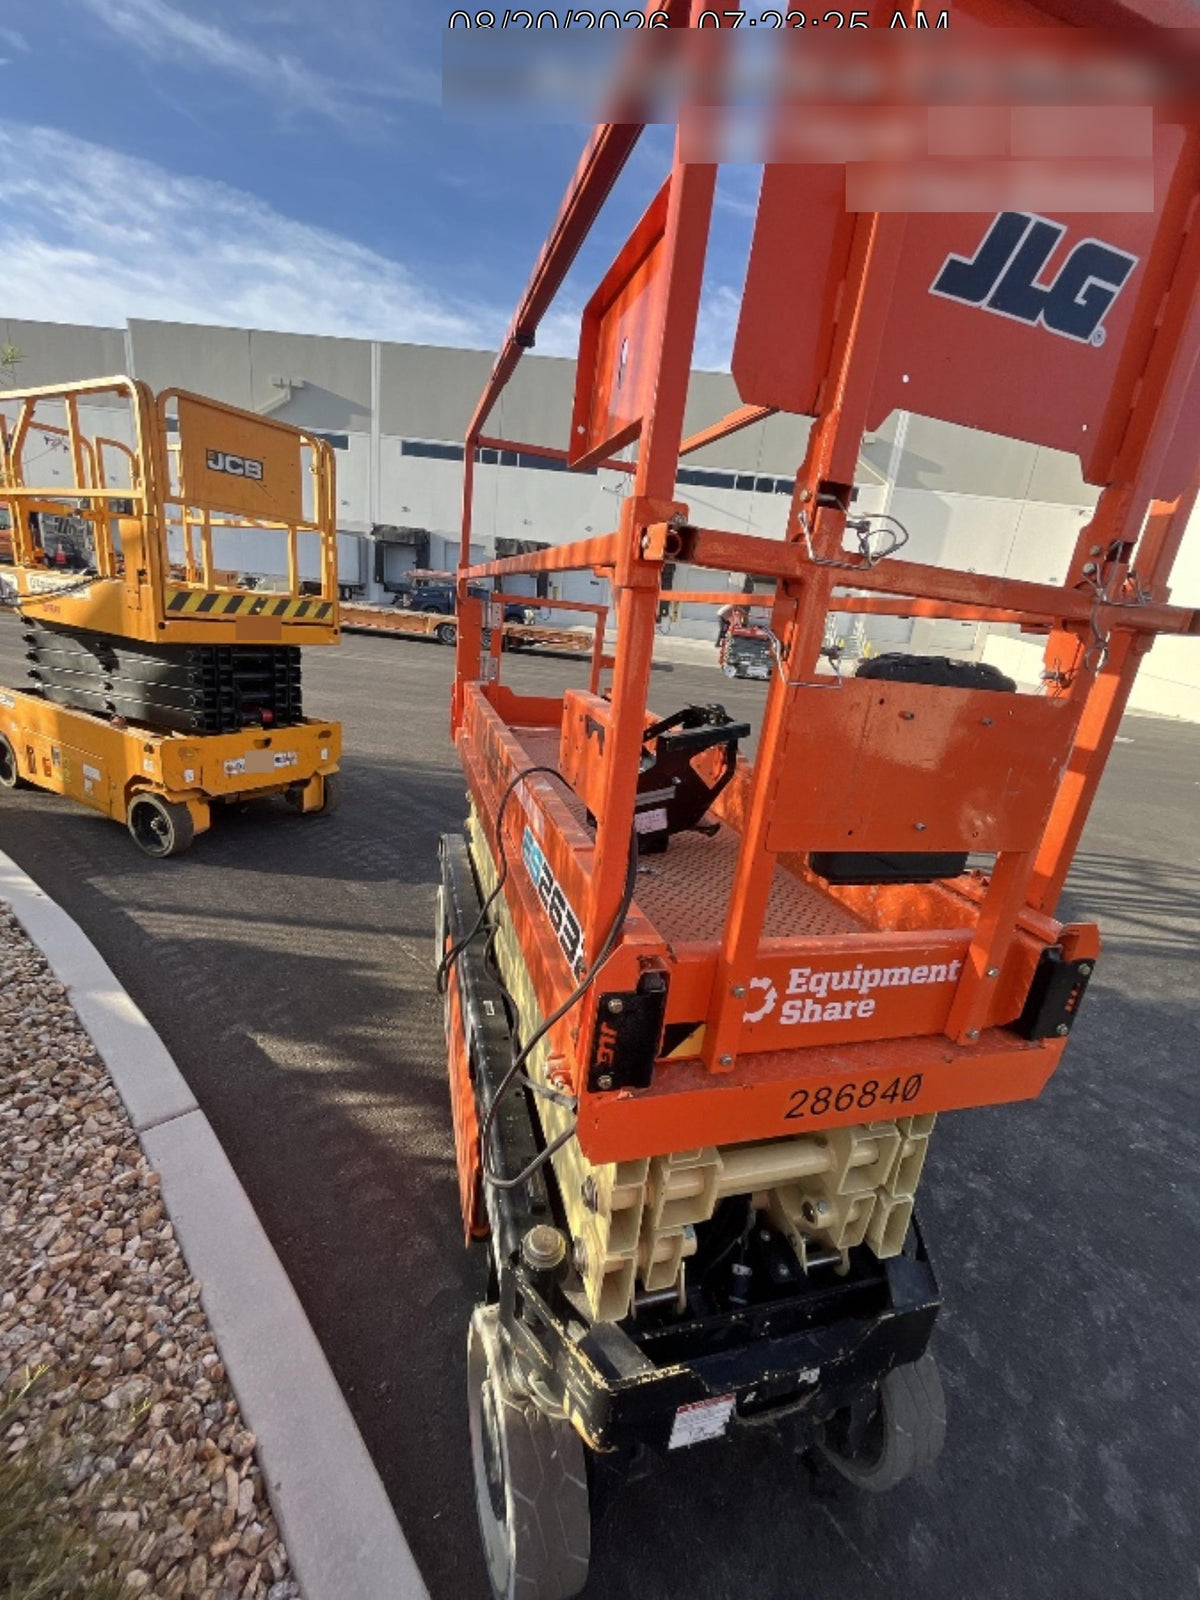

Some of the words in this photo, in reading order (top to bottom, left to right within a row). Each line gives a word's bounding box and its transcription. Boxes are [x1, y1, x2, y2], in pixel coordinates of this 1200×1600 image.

[928, 211, 1140, 346] JLG
[206, 449, 263, 480] JCB
[785, 959, 962, 998] Equipment
[779, 998, 876, 1025] Share
[784, 1072, 924, 1119] 286840
